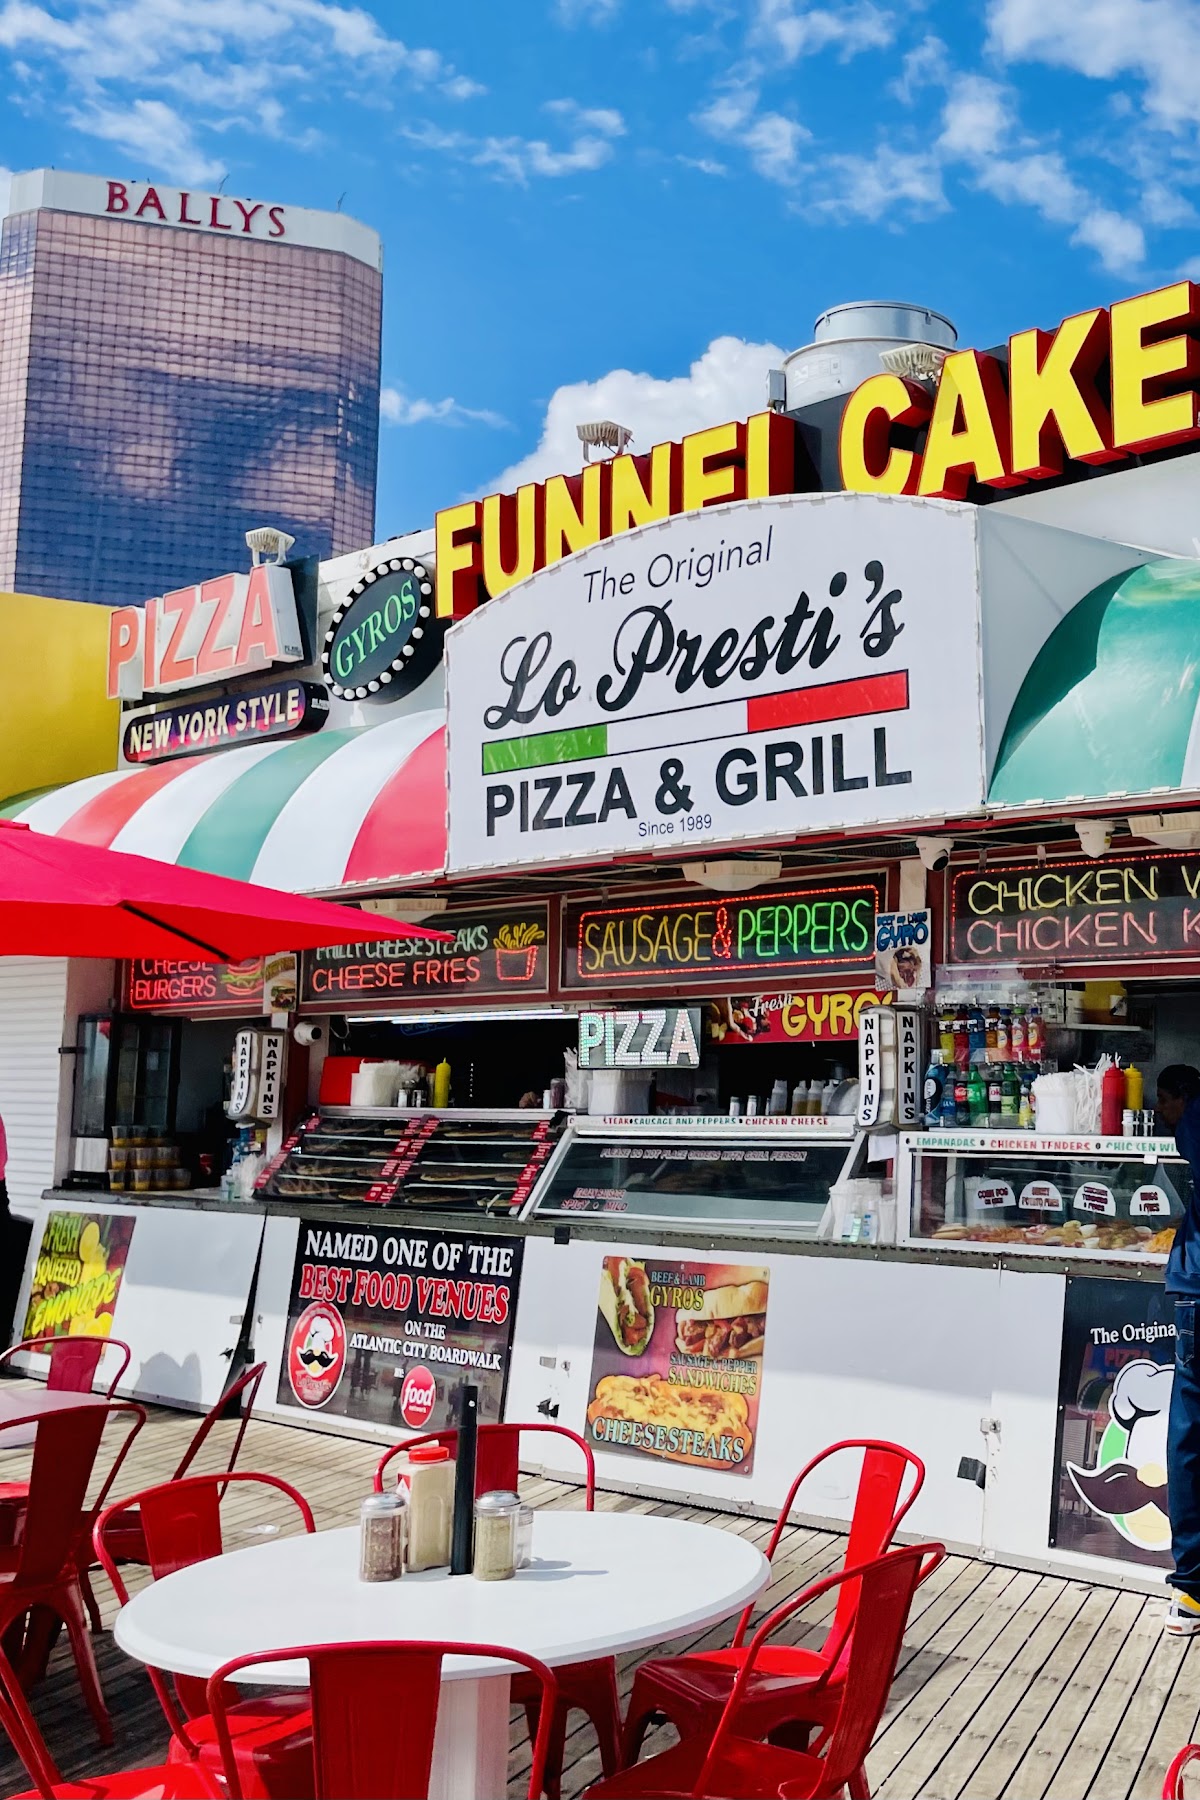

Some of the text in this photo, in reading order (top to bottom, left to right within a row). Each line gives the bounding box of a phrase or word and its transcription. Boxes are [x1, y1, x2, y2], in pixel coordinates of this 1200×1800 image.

[106, 181, 285, 237] BALLYS
[839, 280, 1200, 498] CAKE
[584, 524, 773, 602] The Original
[107, 564, 281, 700] PIZZA
[335, 580, 416, 678] GYROS
[483, 560, 905, 729] Lo Presti's
[129, 688, 300, 754] NEW YORK STYLE
[485, 727, 912, 837] PIZZA & GRILL
[637, 814, 712, 837] Since 1989
[968, 867, 1159, 915] CHICKEN
[585, 899, 872, 971] SAUSAGE & PEPPERS
[877, 922, 928, 952] GYRO
[967, 910, 1157, 955] CHICKEN
[135, 974, 217, 1000] BURGERS
[312, 962, 406, 991] CHEESE
[413, 956, 480, 985] FRIES
[749, 991, 893, 1037] Fresh GYR
[579, 1009, 700, 1067] PIZZA
[233, 1036, 249, 1112] NAPKINS
[263, 1038, 277, 1115] NAPKINS
[861, 1017, 876, 1121] NAPKINS
[902, 1015, 915, 1120] NAPKINS
[916, 1138, 976, 1147] EMPANADAS
[990, 1140, 1037, 1149] CHICKEN
[34, 1256, 82, 1287] SQUEEZED
[304, 1229, 514, 1277] NAMED ONE OF THE
[299, 1264, 510, 1324] BEST FOOD VENUES
[650, 1285, 705, 1311] GYROS
[651, 1271, 673, 1284] BEEF
[681, 1274, 706, 1287] LAMB
[349, 1334, 502, 1370] ATLANTIC CITY BOARDWALK
[405, 1320, 446, 1340] ON THE
[1090, 1321, 1178, 1345] The Origina
[667, 1366, 758, 1395] SANDWICHES
[670, 1354, 710, 1369] SAUSAGE
[720, 1358, 758, 1374] PEPPER
[401, 1379, 434, 1410] food
[592, 1416, 745, 1463] CHEESESTEAKS
